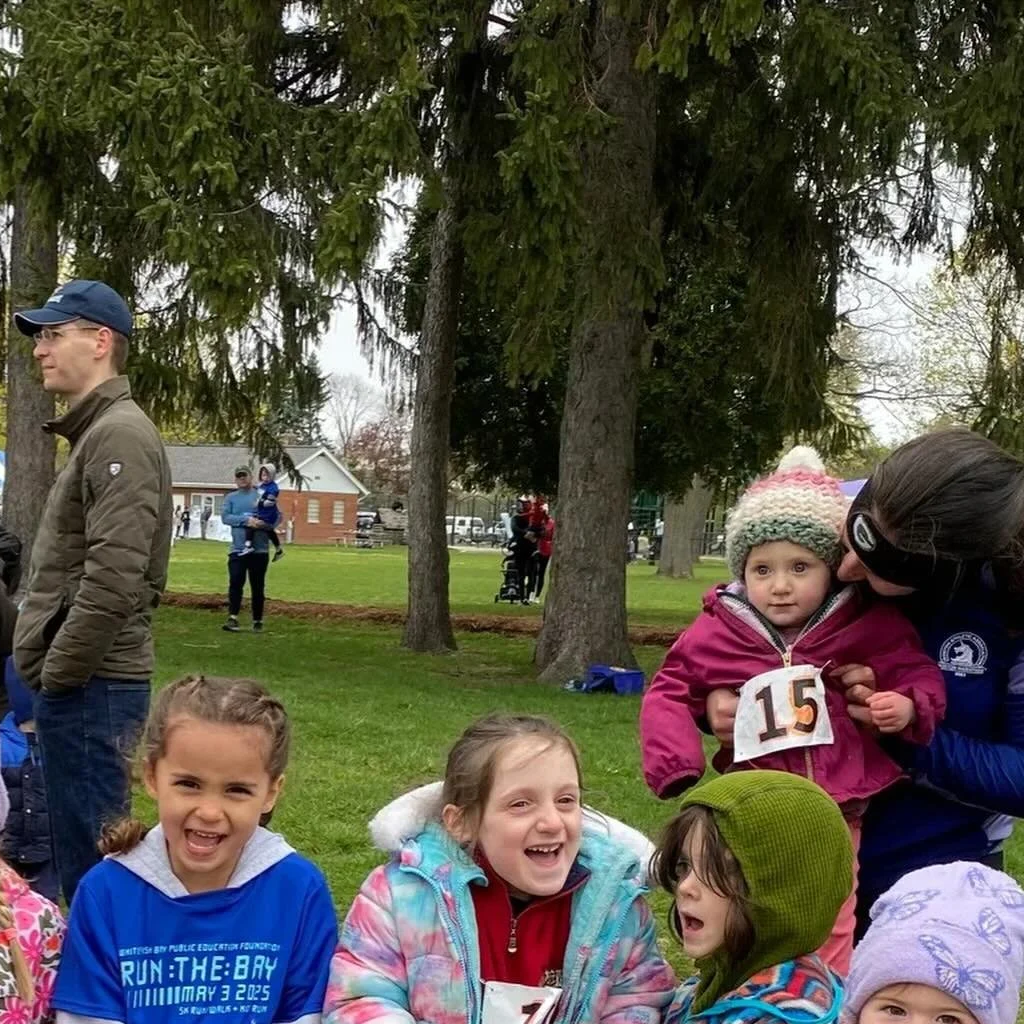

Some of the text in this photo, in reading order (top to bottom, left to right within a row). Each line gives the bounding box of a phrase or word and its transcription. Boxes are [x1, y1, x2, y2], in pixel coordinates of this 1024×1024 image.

[755, 679, 818, 742] 15
[181, 984, 271, 1003] MAY 3 2025
